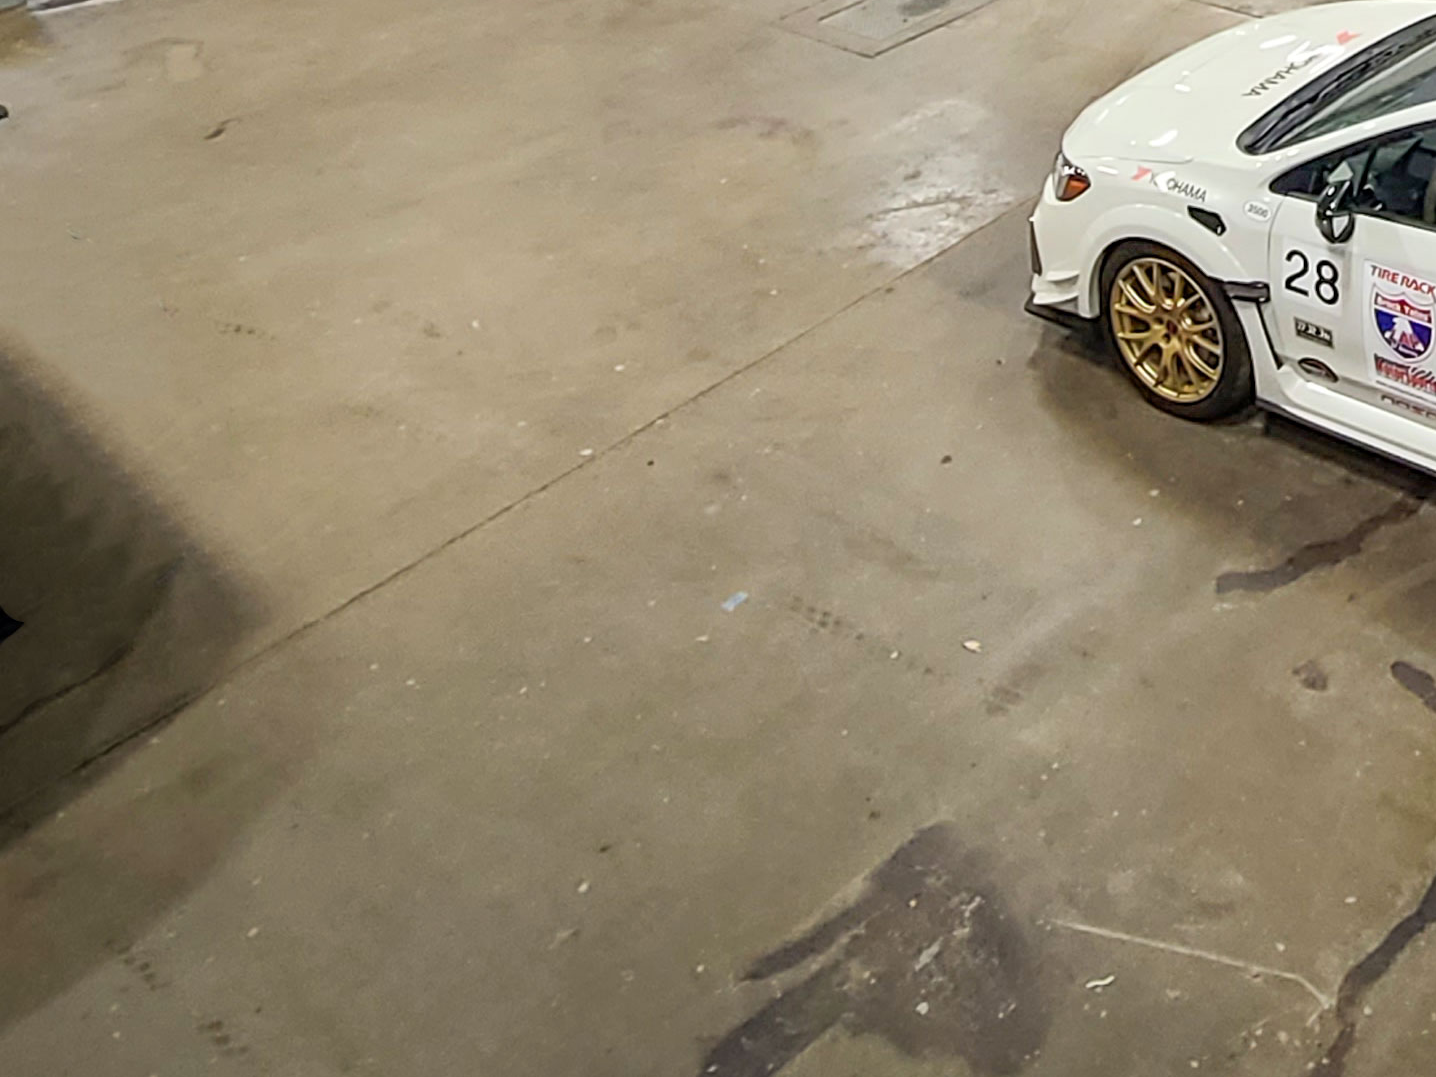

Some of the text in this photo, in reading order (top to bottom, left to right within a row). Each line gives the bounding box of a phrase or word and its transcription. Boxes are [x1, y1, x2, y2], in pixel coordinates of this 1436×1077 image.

[1284, 249, 1340, 305] 28
[1371, 264, 1436, 296] TIRE RACK
